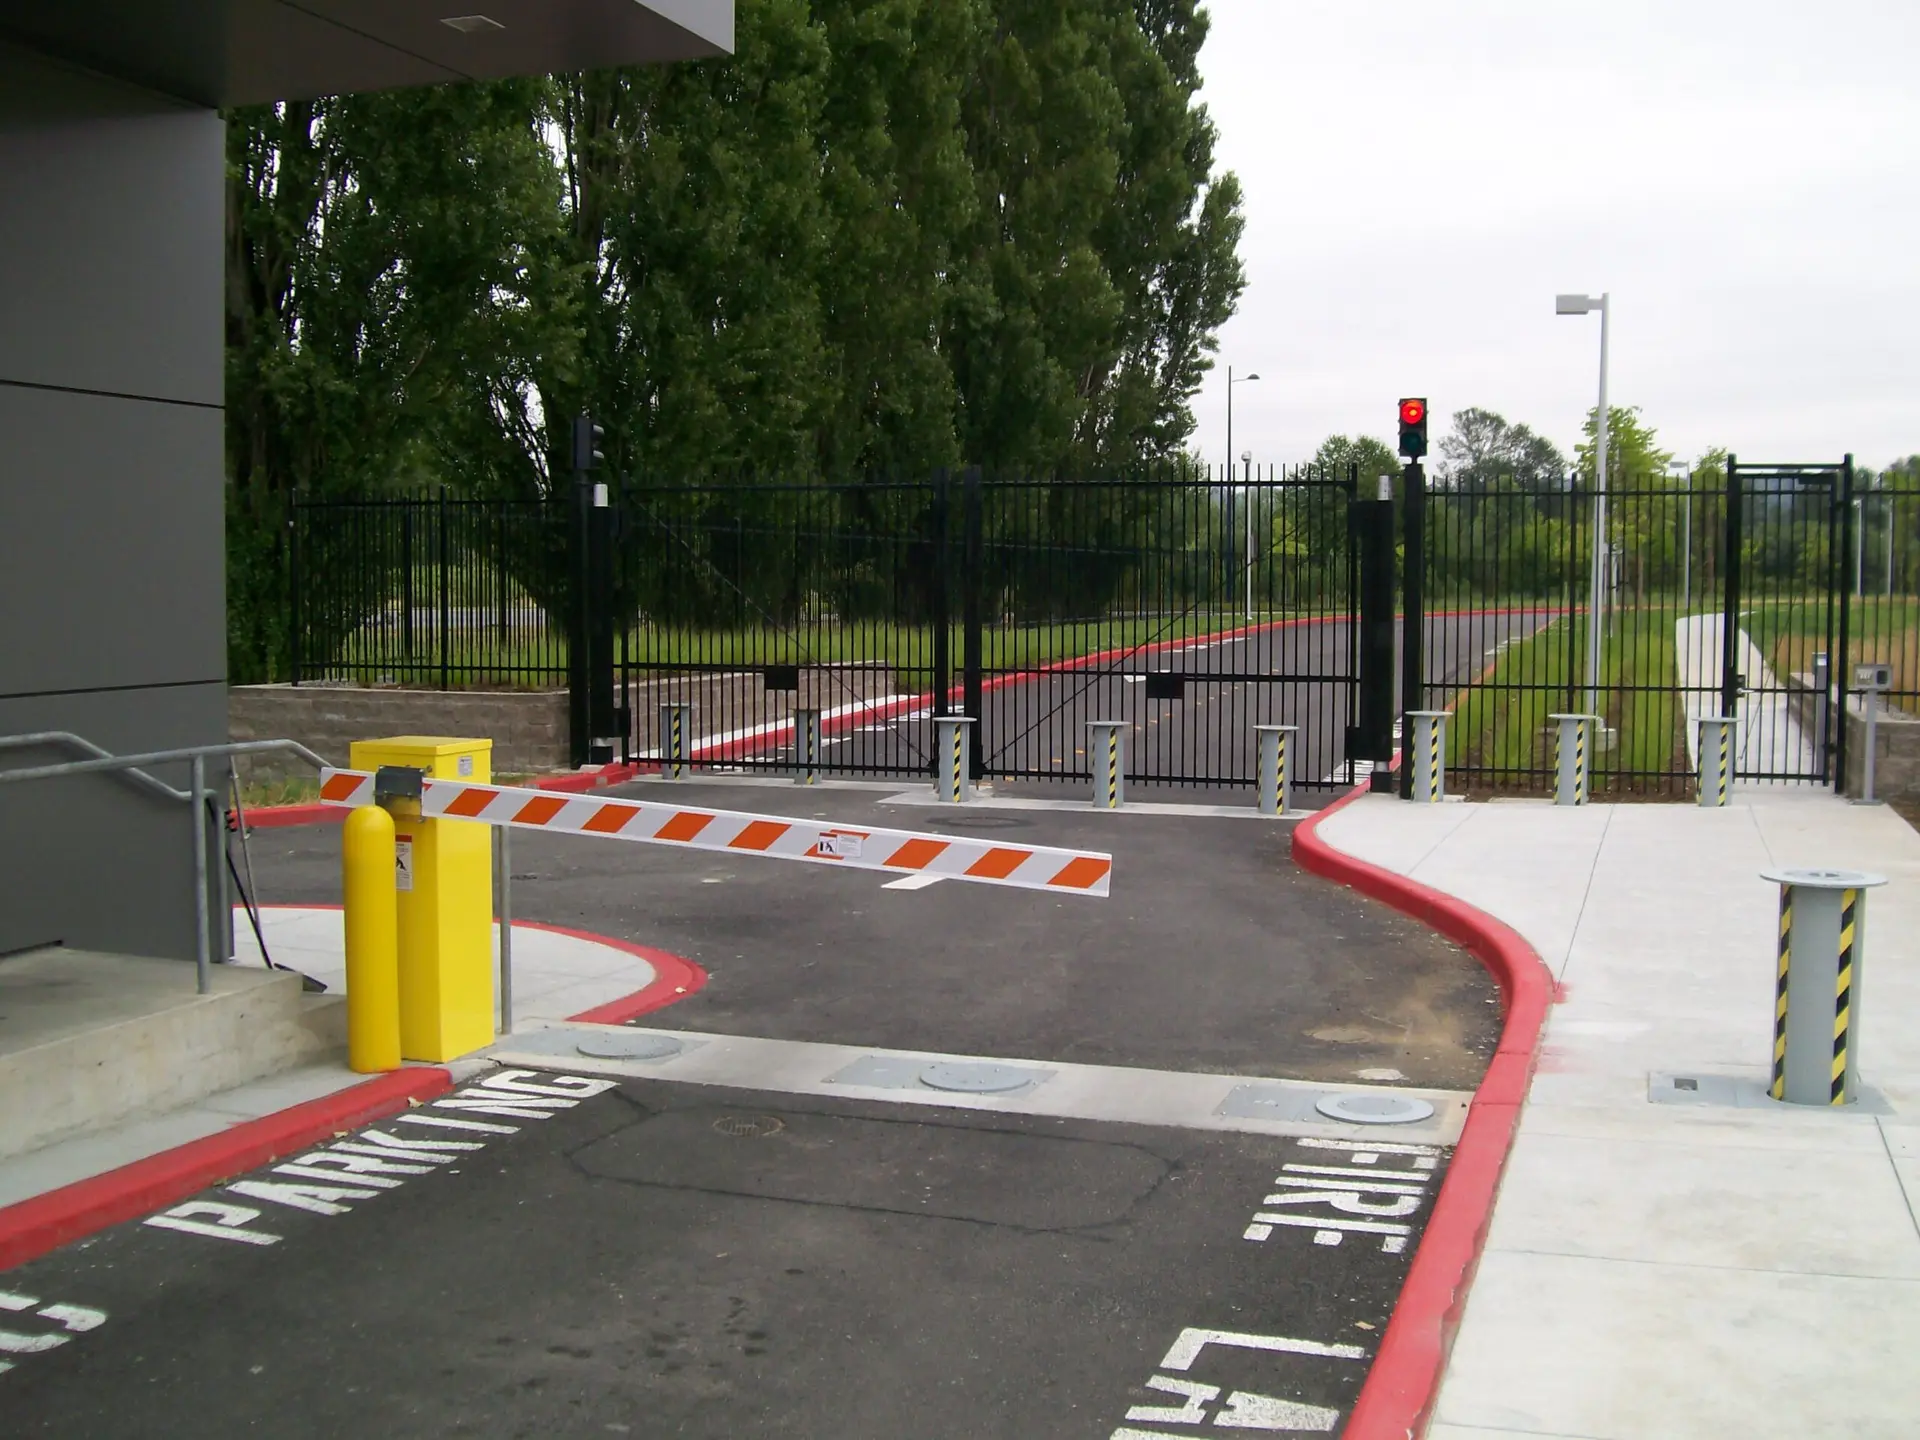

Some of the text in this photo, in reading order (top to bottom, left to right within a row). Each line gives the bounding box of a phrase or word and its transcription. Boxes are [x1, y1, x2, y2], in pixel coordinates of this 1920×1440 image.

[142, 1070, 621, 1245] PARKING
[1242, 1138, 1442, 1253] FIRE
[1109, 1327, 1365, 1440] LA
